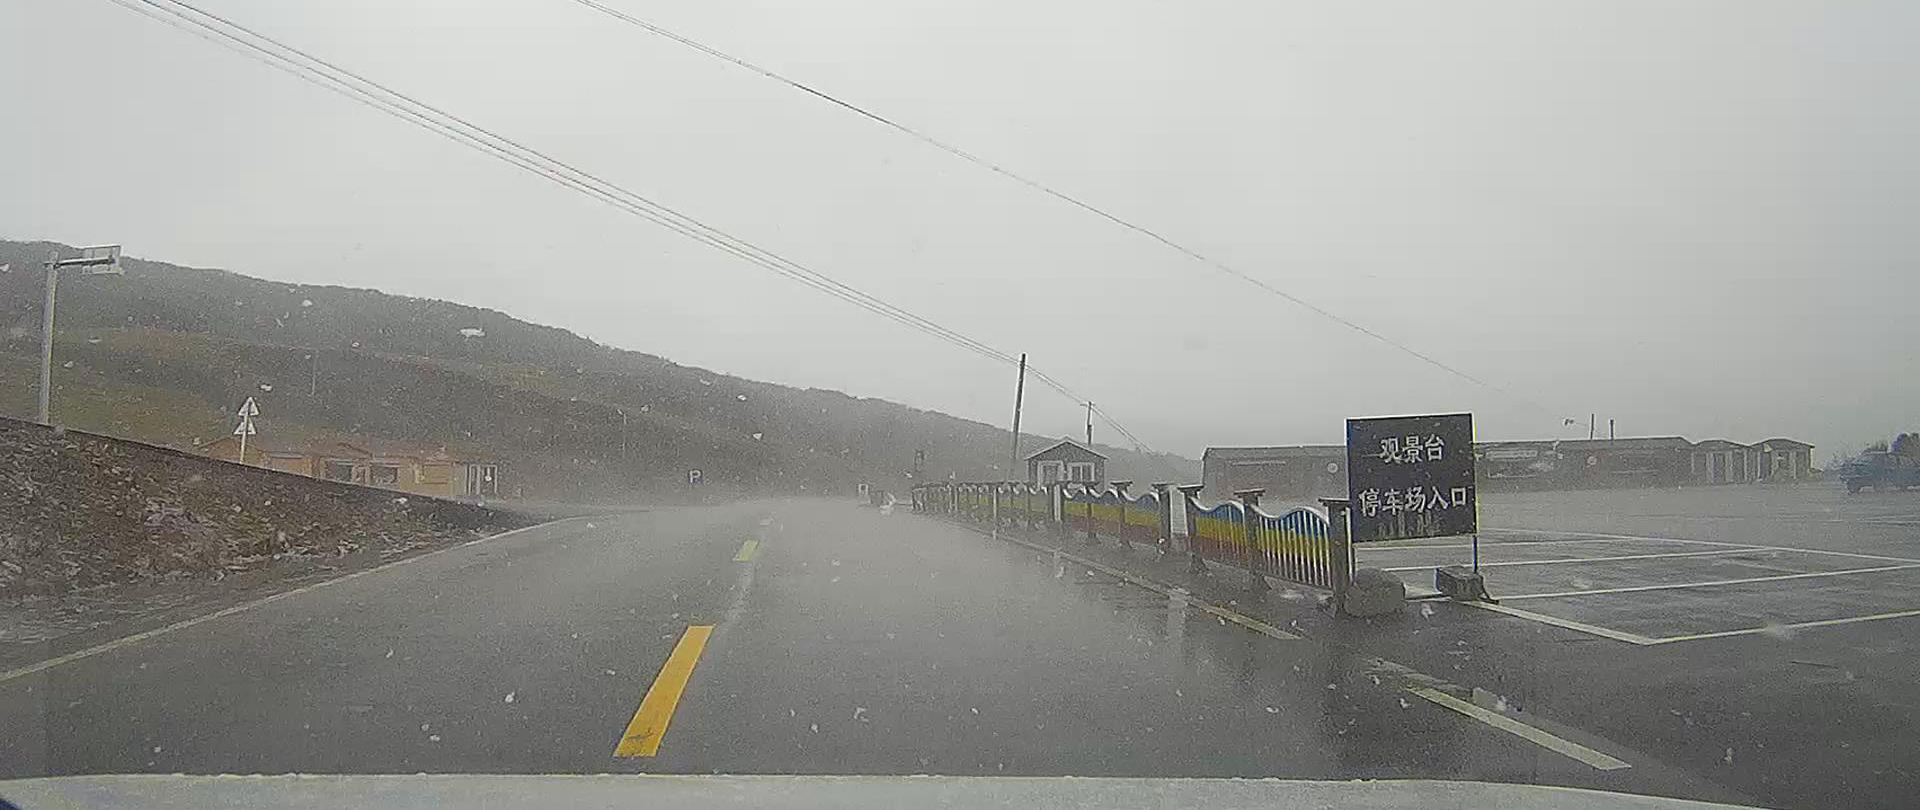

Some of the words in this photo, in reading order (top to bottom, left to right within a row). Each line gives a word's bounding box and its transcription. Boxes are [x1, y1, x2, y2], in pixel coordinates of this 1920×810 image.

[1380, 434, 1445, 464] 观景台
[689, 469, 702, 483] P
[1359, 486, 1466, 517] 停车场入口
